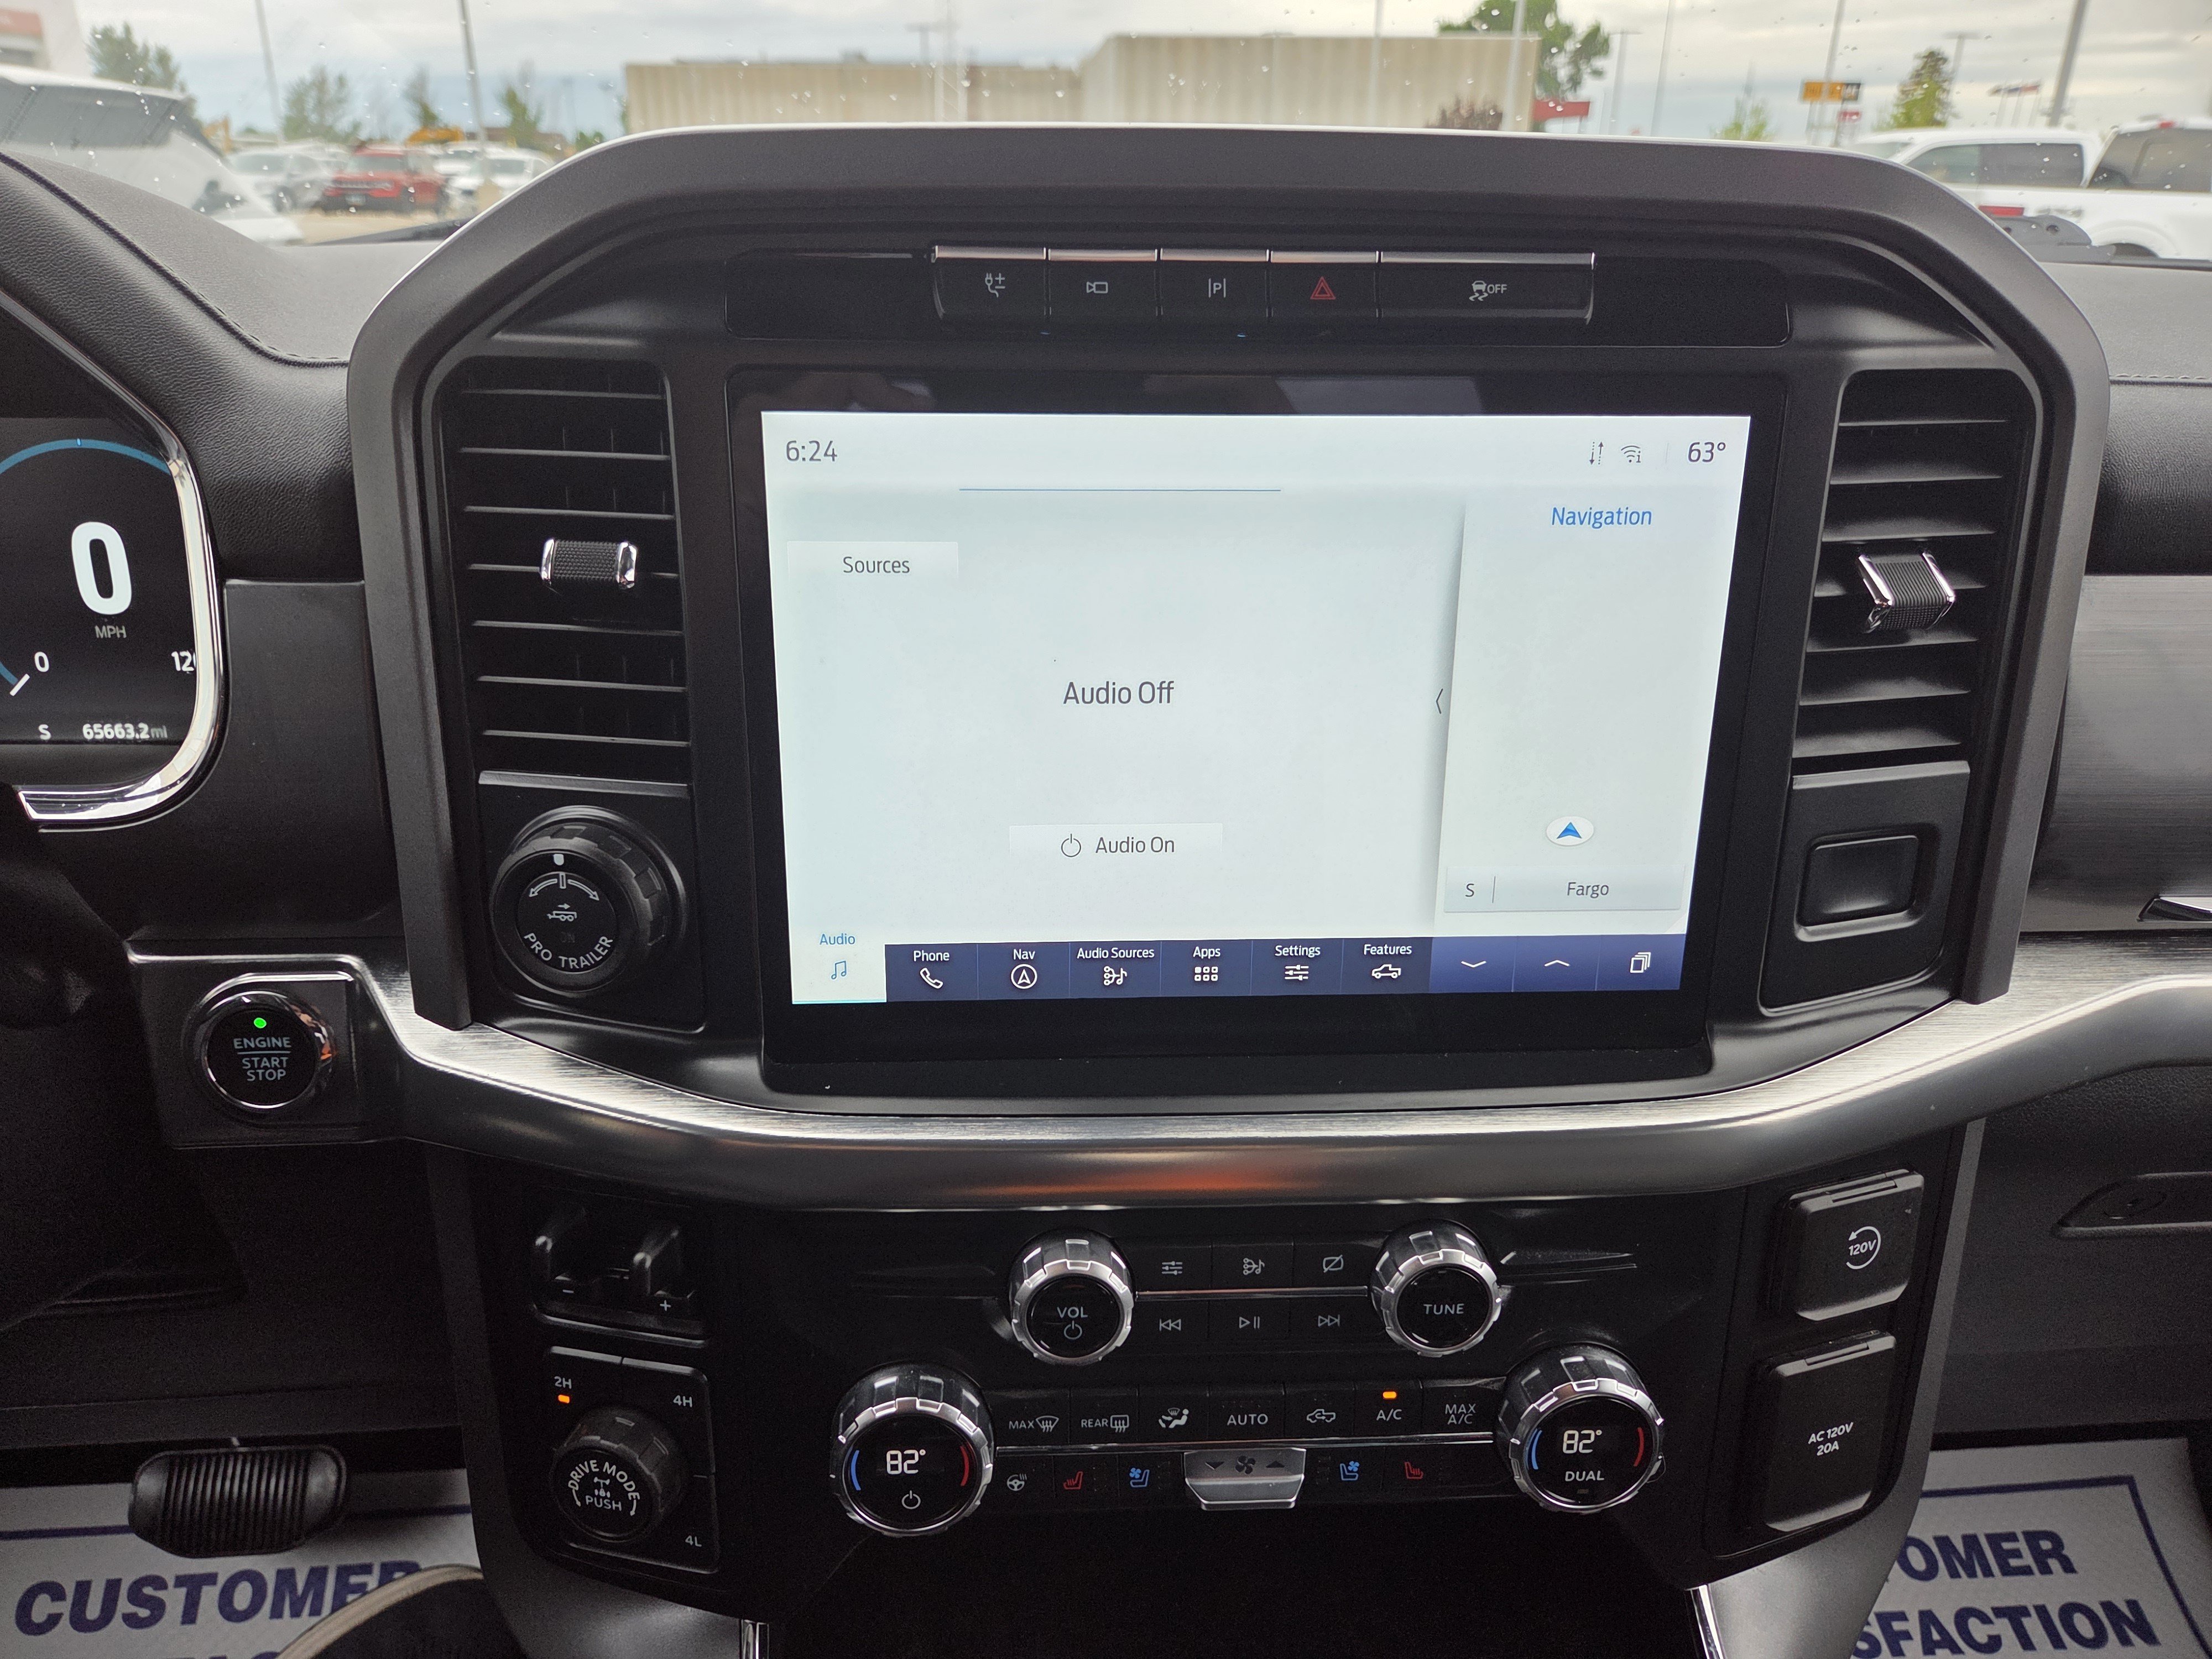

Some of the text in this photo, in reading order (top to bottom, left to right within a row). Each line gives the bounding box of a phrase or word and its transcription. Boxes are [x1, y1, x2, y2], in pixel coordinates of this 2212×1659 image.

[1486, 284, 1507, 294] OFF
[786, 440, 838, 462] 6:24
[1552, 507, 1652, 529] Navigation
[71, 521, 132, 615] 0
[843, 556, 910, 573] Sources
[95, 625, 127, 639] MPH
[34, 651, 49, 672] 0
[171, 650, 196, 671] 12
[1063, 680, 1175, 705] Audio Off
[38, 724, 51, 740] S
[1095, 836, 1175, 853] Audio On
[1465, 883, 1475, 898] S
[1567, 881, 1609, 899] Fargo
[820, 933, 855, 945] Audio
[523, 932, 613, 969] PRO TRAILER
[914, 950, 950, 962] Phone
[1013, 948, 1036, 960] Nav
[1077, 947, 1155, 959] Audio Sources
[1193, 946, 1221, 959] Apps
[1275, 945, 1321, 958] Settings
[1364, 944, 1412, 955] Features
[233, 1036, 291, 1049] ENGINE
[242, 1057, 289, 1069] START
[247, 1069, 286, 1082] STOP
[1849, 1239, 1876, 1255] 120V
[1057, 1306, 1088, 1318] VOL
[1423, 1303, 1464, 1315] TUNE
[554, 1376, 572, 1389] 2H
[673, 1395, 693, 1408] 4H
[1376, 1408, 1402, 1421] A/C
[1445, 1403, 1476, 1414] MAX
[1009, 1420, 1035, 1430] MAX
[1081, 1418, 1108, 1428] REAR
[1227, 1413, 1268, 1426] AUTO
[1447, 1413, 1473, 1425] A/C
[1808, 1422, 1854, 1444] AC 120V
[1816, 1441, 1839, 1456] 20A
[568, 1459, 640, 1500] DRIVE MODE
[1564, 1470, 1605, 1481] DUAL
[585, 1495, 622, 1511] PUSH
[685, 1535, 702, 1547] 4L
[1896, 1530, 2078, 1582] OMER
